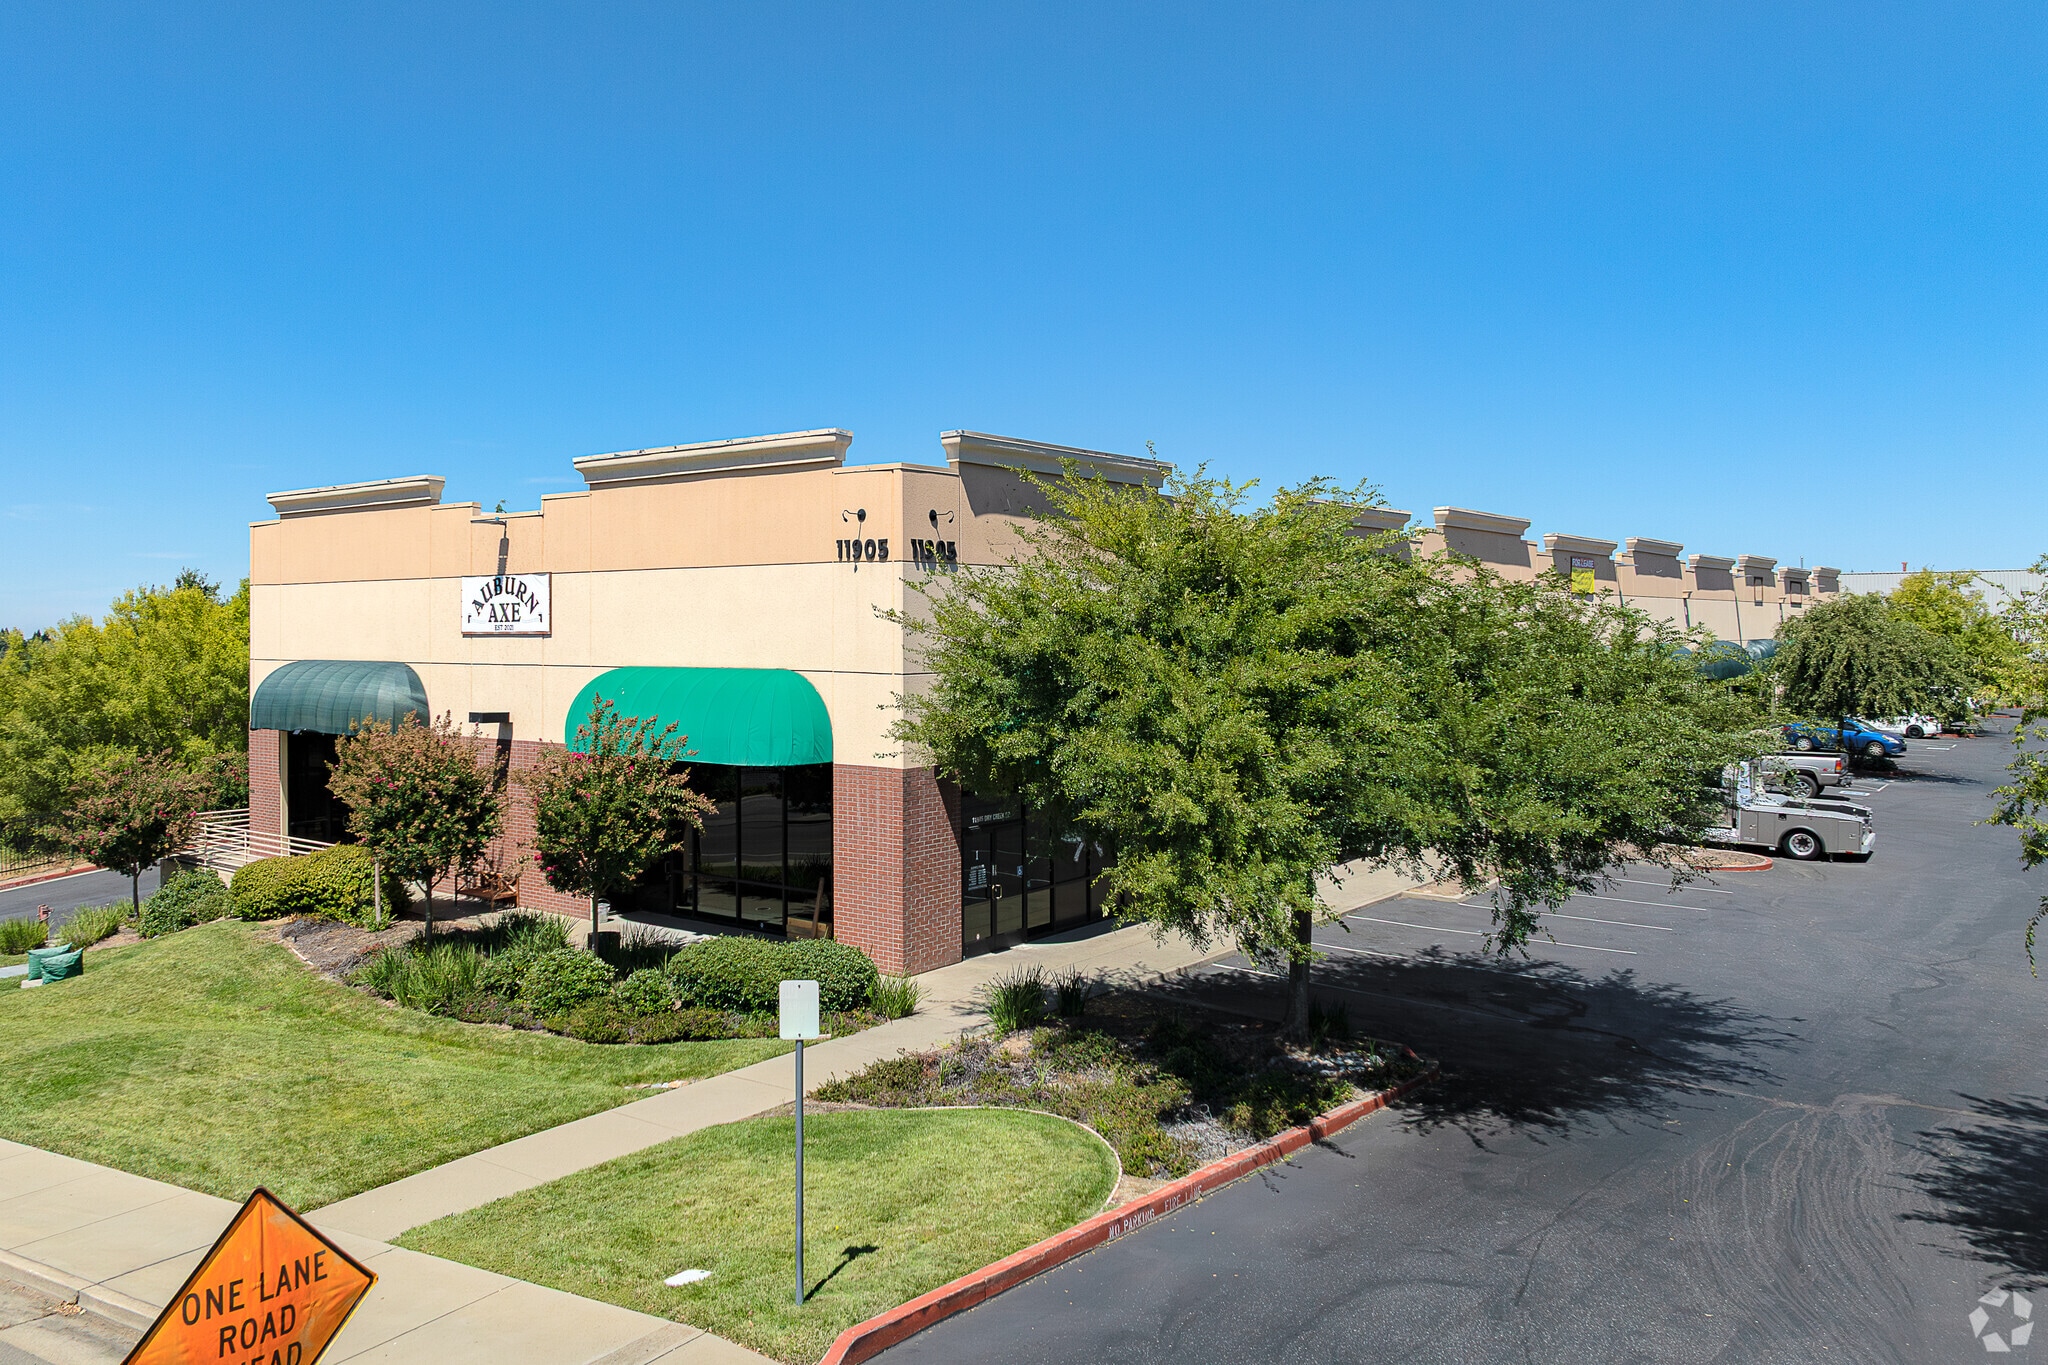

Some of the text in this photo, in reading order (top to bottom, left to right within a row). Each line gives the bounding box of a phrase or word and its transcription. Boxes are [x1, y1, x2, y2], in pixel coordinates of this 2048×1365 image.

[836, 538, 889, 562] 11905
[472, 576, 539, 616] AUBURN
[488, 602, 521, 623] AXE
[1109, 1224, 1120, 1238] NO
[1124, 1208, 1155, 1233] PARKING
[1164, 1194, 1180, 1212] FIRE
[182, 1250, 328, 1326] ONE LANE
[219, 1304, 296, 1358] ROAD
